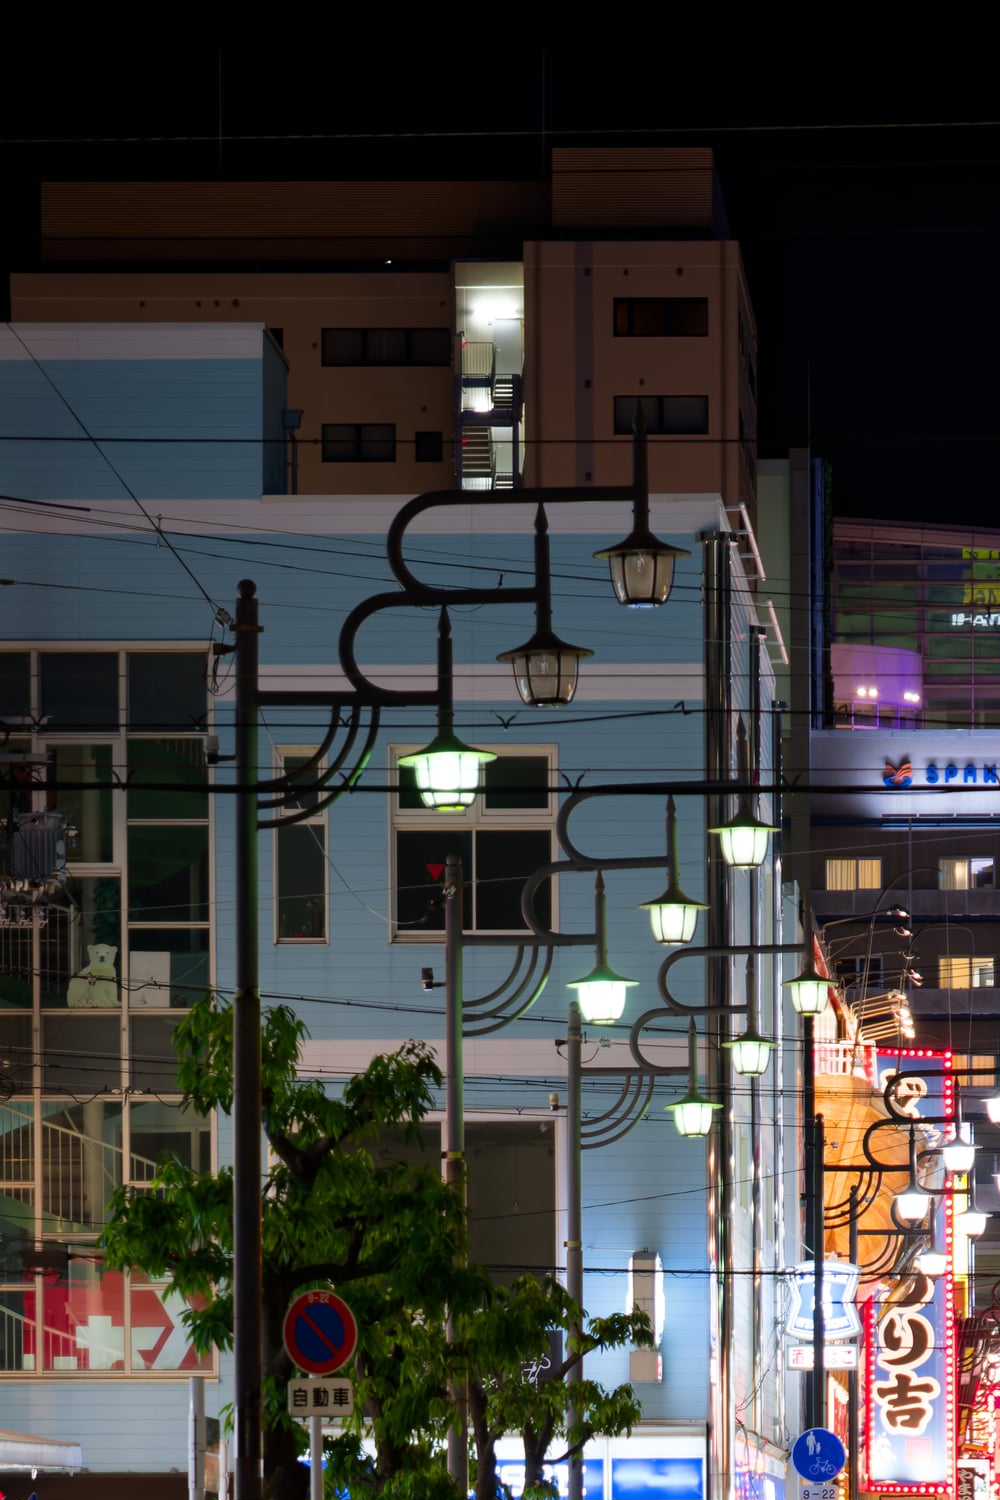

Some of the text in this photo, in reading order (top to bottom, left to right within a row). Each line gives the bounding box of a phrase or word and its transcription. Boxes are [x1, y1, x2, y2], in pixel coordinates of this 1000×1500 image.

[293, 1387, 350, 1407] 自動車
[803, 1489, 836, 1500] 9-22
